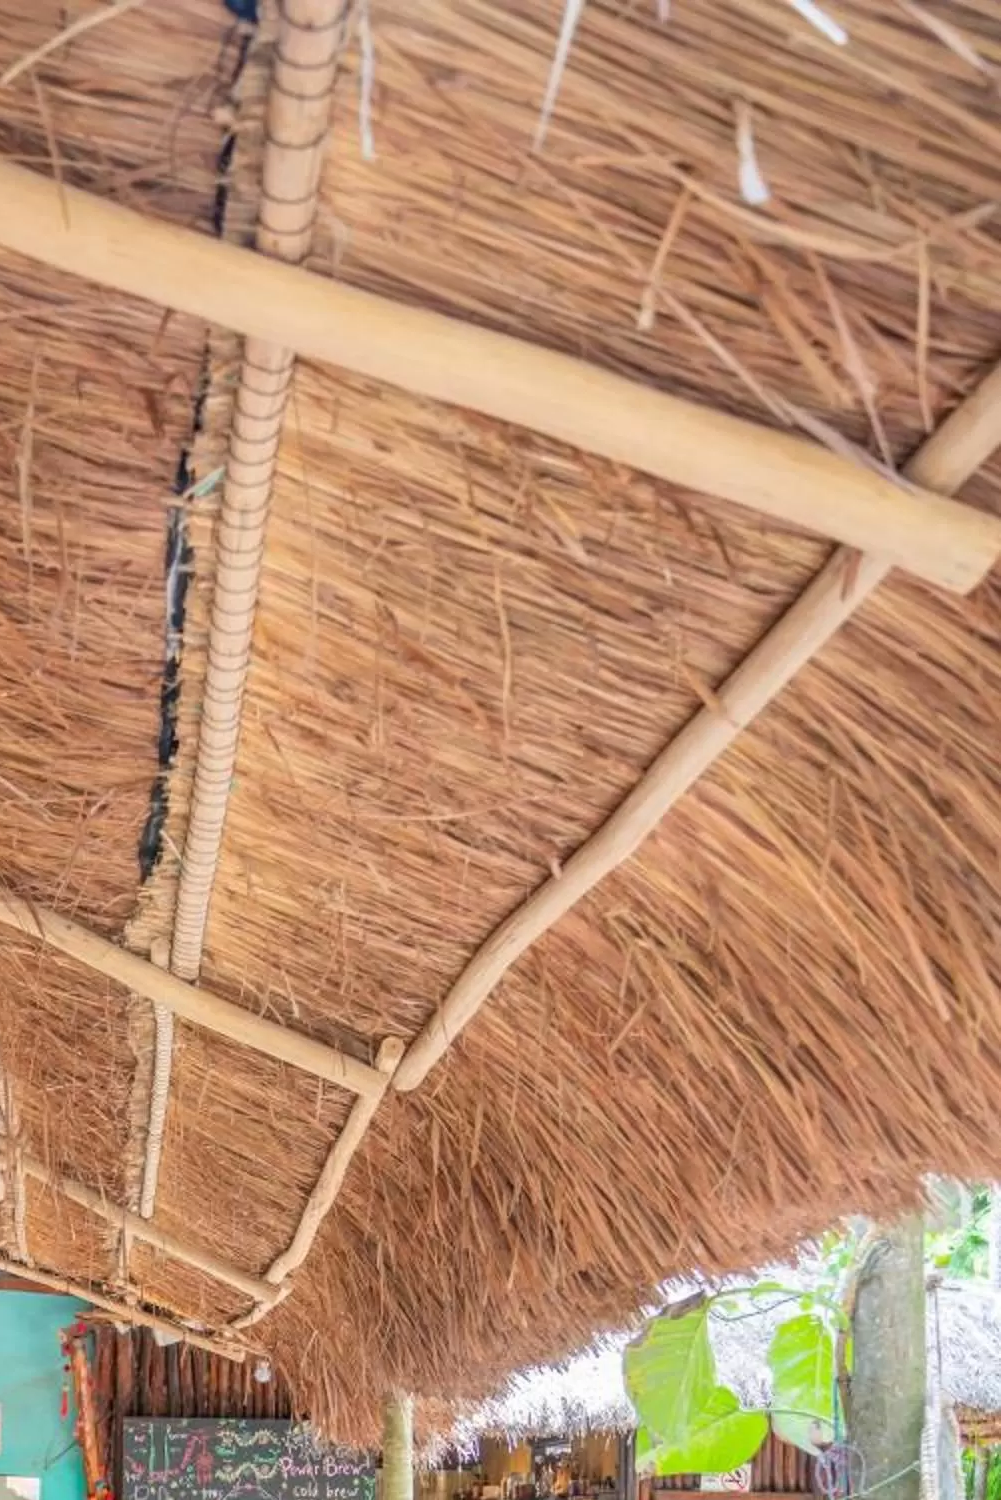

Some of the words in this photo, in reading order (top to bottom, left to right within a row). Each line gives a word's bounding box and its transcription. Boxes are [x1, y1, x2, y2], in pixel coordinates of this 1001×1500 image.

[325, 1456, 361, 1477] Brew
[293, 1481, 318, 1497] cold
[326, 1481, 359, 1498] brew
